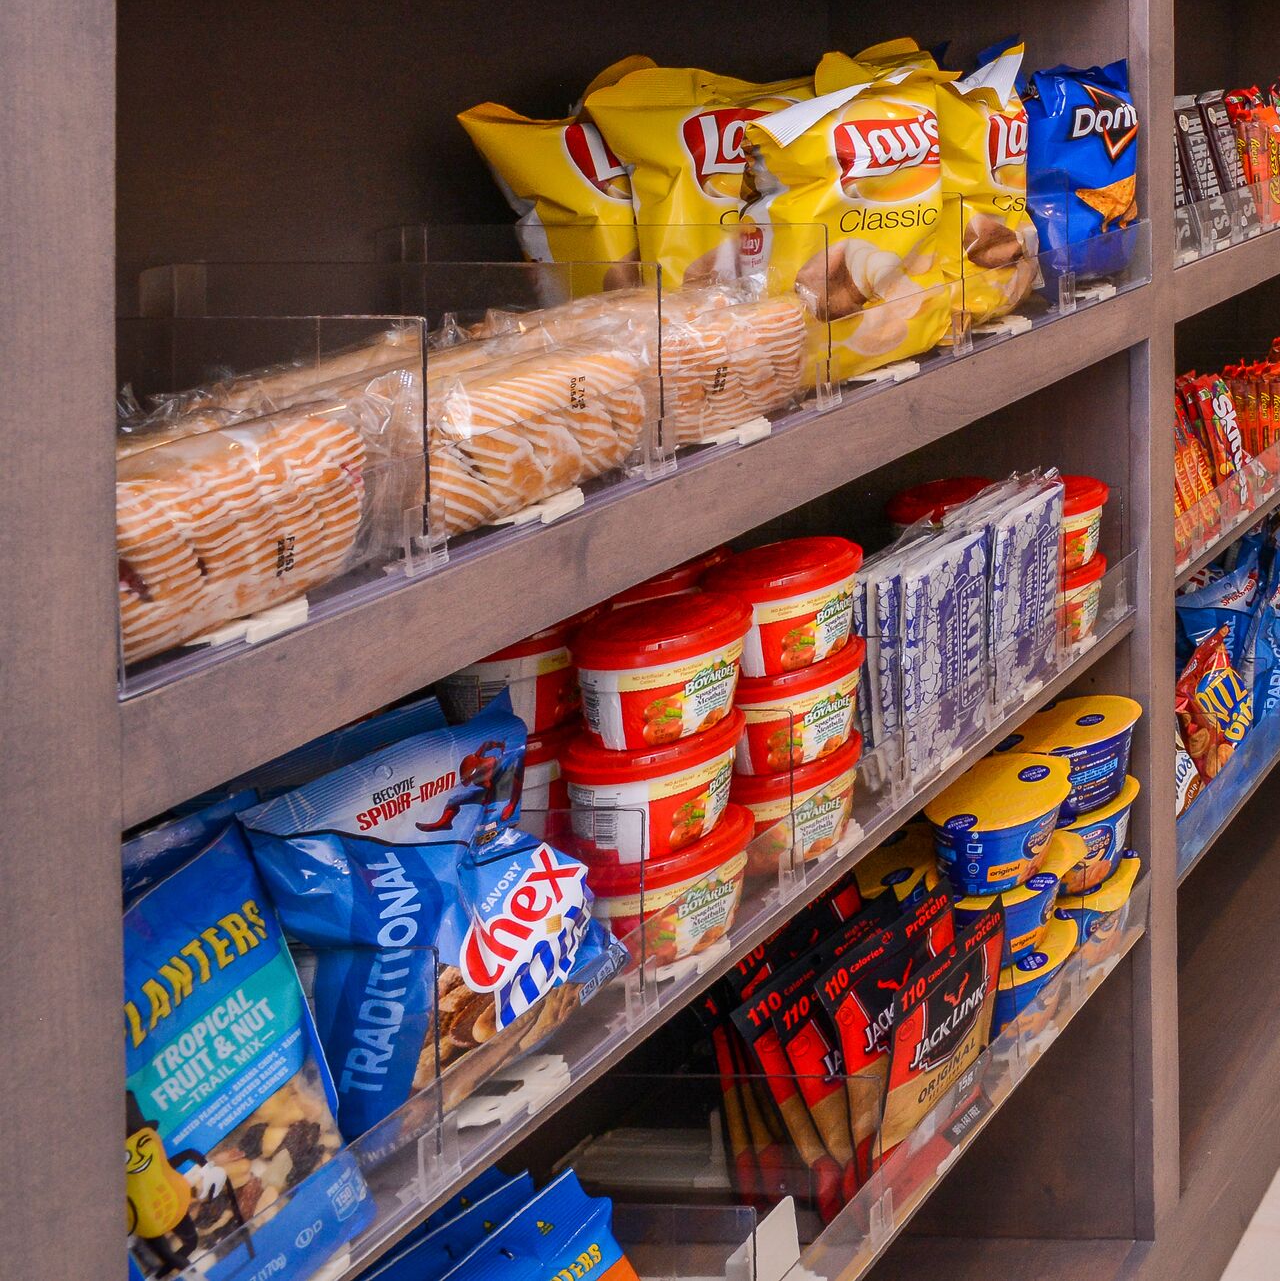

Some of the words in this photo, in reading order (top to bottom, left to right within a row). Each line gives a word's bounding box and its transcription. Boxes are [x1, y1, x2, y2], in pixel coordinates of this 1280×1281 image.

[1072, 102, 1138, 139] Dorit
[843, 115, 940, 179] Lay's
[1270, 135, 1280, 205] Reese's
[839, 203, 938, 234] Classic
[1212, 394, 1249, 505] Skittles
[684, 662, 736, 698] BOYARDEE
[694, 684, 725, 702] Spaghetti
[697, 689, 728, 708] Meatballs
[1196, 668, 1249, 731] RITZ
[803, 694, 851, 728] BOYARDEE
[814, 713, 841, 729] Spaghetti
[816, 718, 845, 735] Meatballs
[356, 770, 457, 832] SPIDER-MAN
[371, 775, 416, 807] BECOME
[480, 861, 523, 914] SAVORY
[989, 863, 1021, 877] original
[465, 848, 582, 988] Chex
[677, 879, 734, 918] BOYARDEE
[905, 892, 948, 938] Protein
[964, 912, 1001, 952] Protein
[1012, 934, 1037, 949] original
[123, 900, 268, 1049] LANTERS
[339, 852, 422, 1097] TRADITIONAL
[824, 968, 849, 1002] 110
[747, 990, 784, 1028] 110
[782, 995, 811, 1031] 110
[901, 979, 927, 1012] 110
[152, 989, 254, 1080] TROPICAL
[910, 1015, 951, 1069] JACK
[151, 1048, 216, 1111] FRUIT
[213, 1036, 238, 1060] &
[230, 998, 276, 1043] NUT
[188, 1065, 235, 1104] TRAIL
[233, 1037, 266, 1067] MIX
[917, 1038, 978, 1105] ORIGINAL
